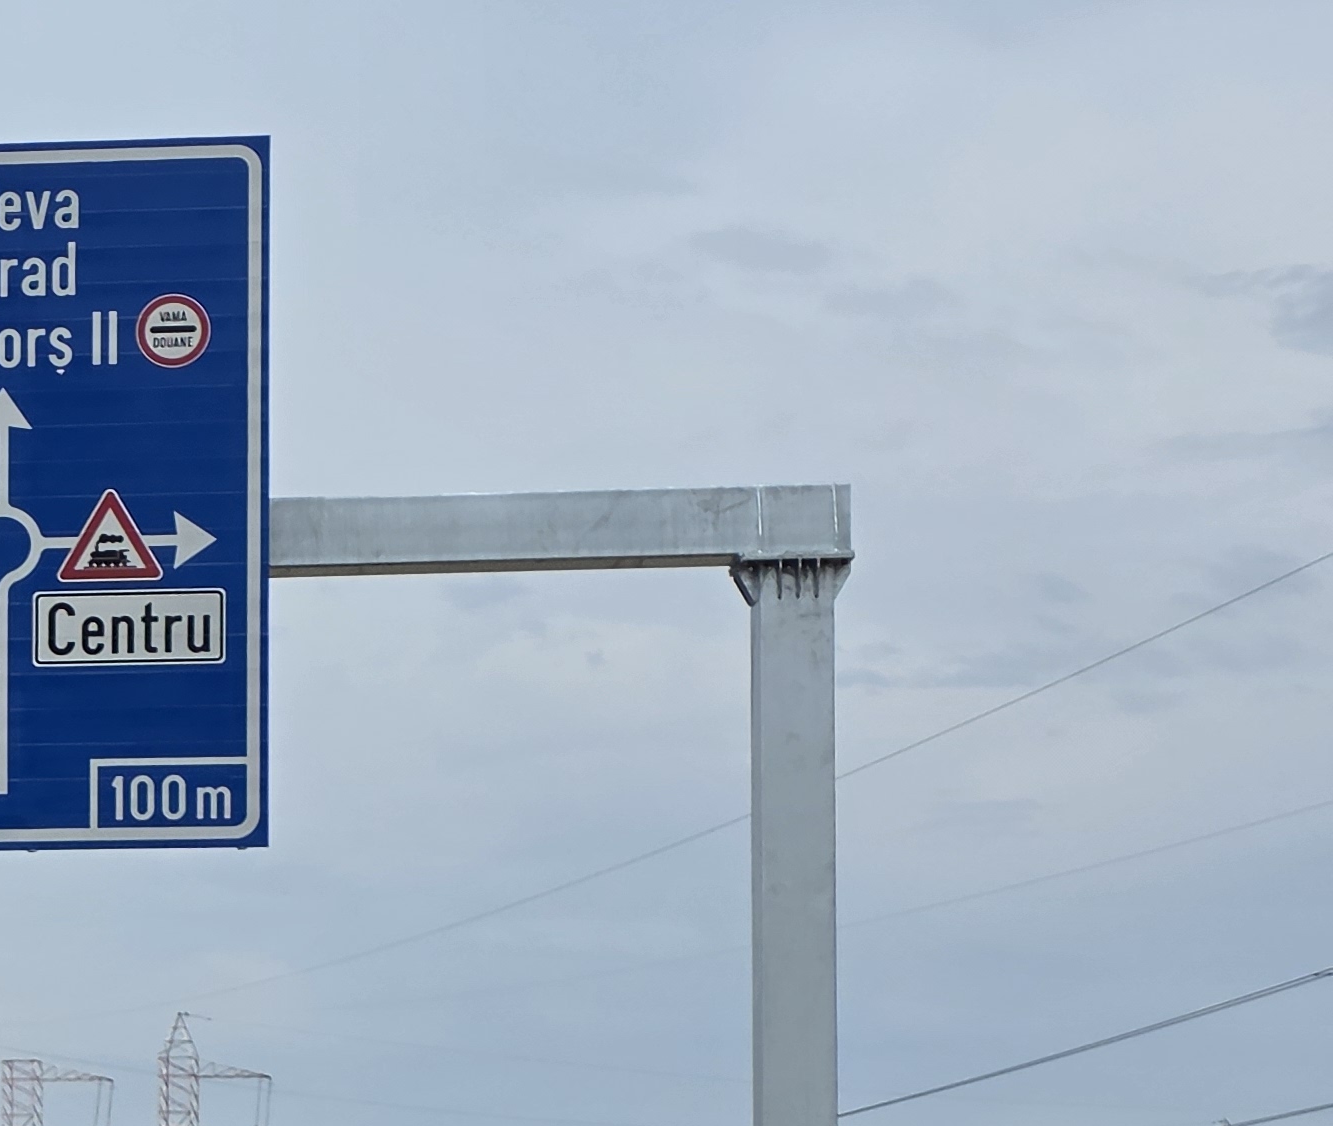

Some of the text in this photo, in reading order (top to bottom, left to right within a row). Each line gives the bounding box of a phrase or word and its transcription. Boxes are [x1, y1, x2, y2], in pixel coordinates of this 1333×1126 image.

[159, 311, 187, 323] VAMA
[91, 310, 118, 366] II
[153, 336, 194, 349] DOUANE
[47, 601, 211, 656] Centru
